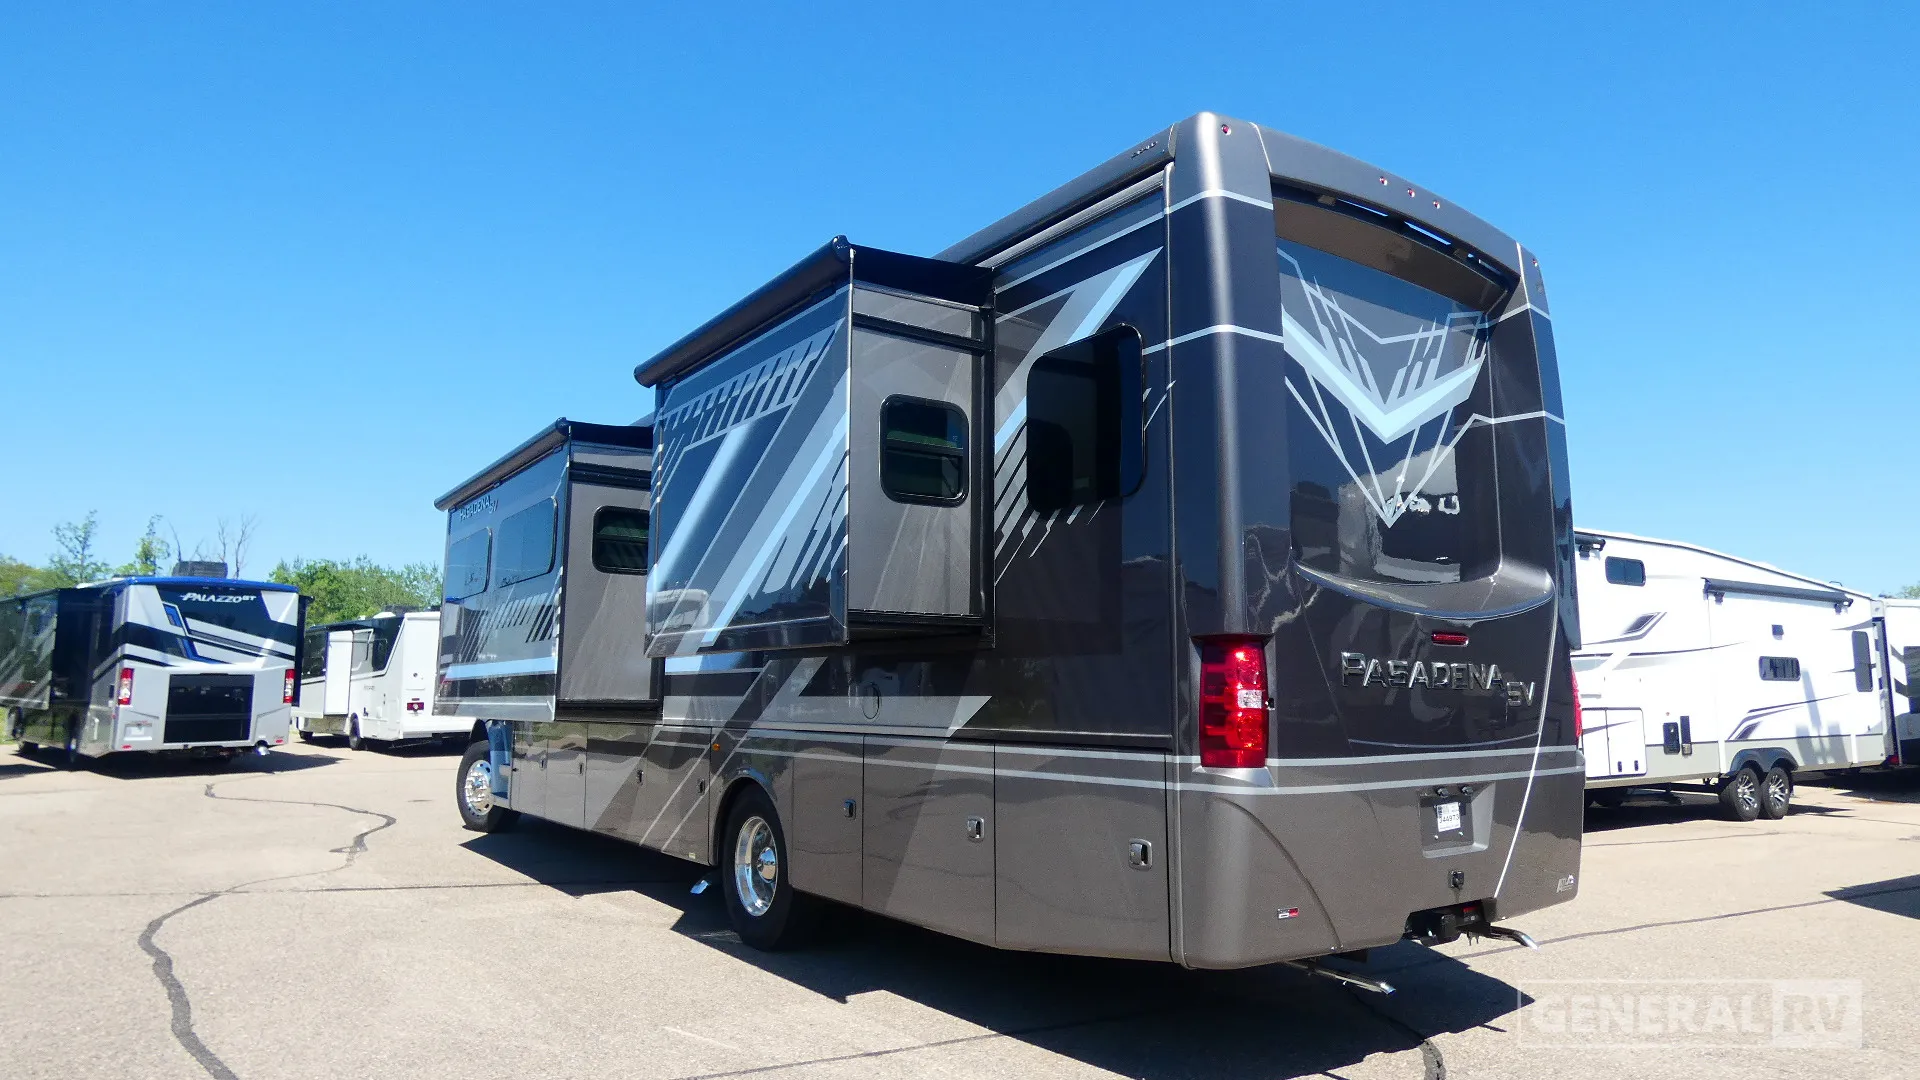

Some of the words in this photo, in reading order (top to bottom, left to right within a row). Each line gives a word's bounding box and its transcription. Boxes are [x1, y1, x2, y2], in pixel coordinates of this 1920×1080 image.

[181, 592, 242, 604] PALAZZO
[1341, 651, 1506, 690] PASADENA
[1506, 681, 1536, 707] SV
